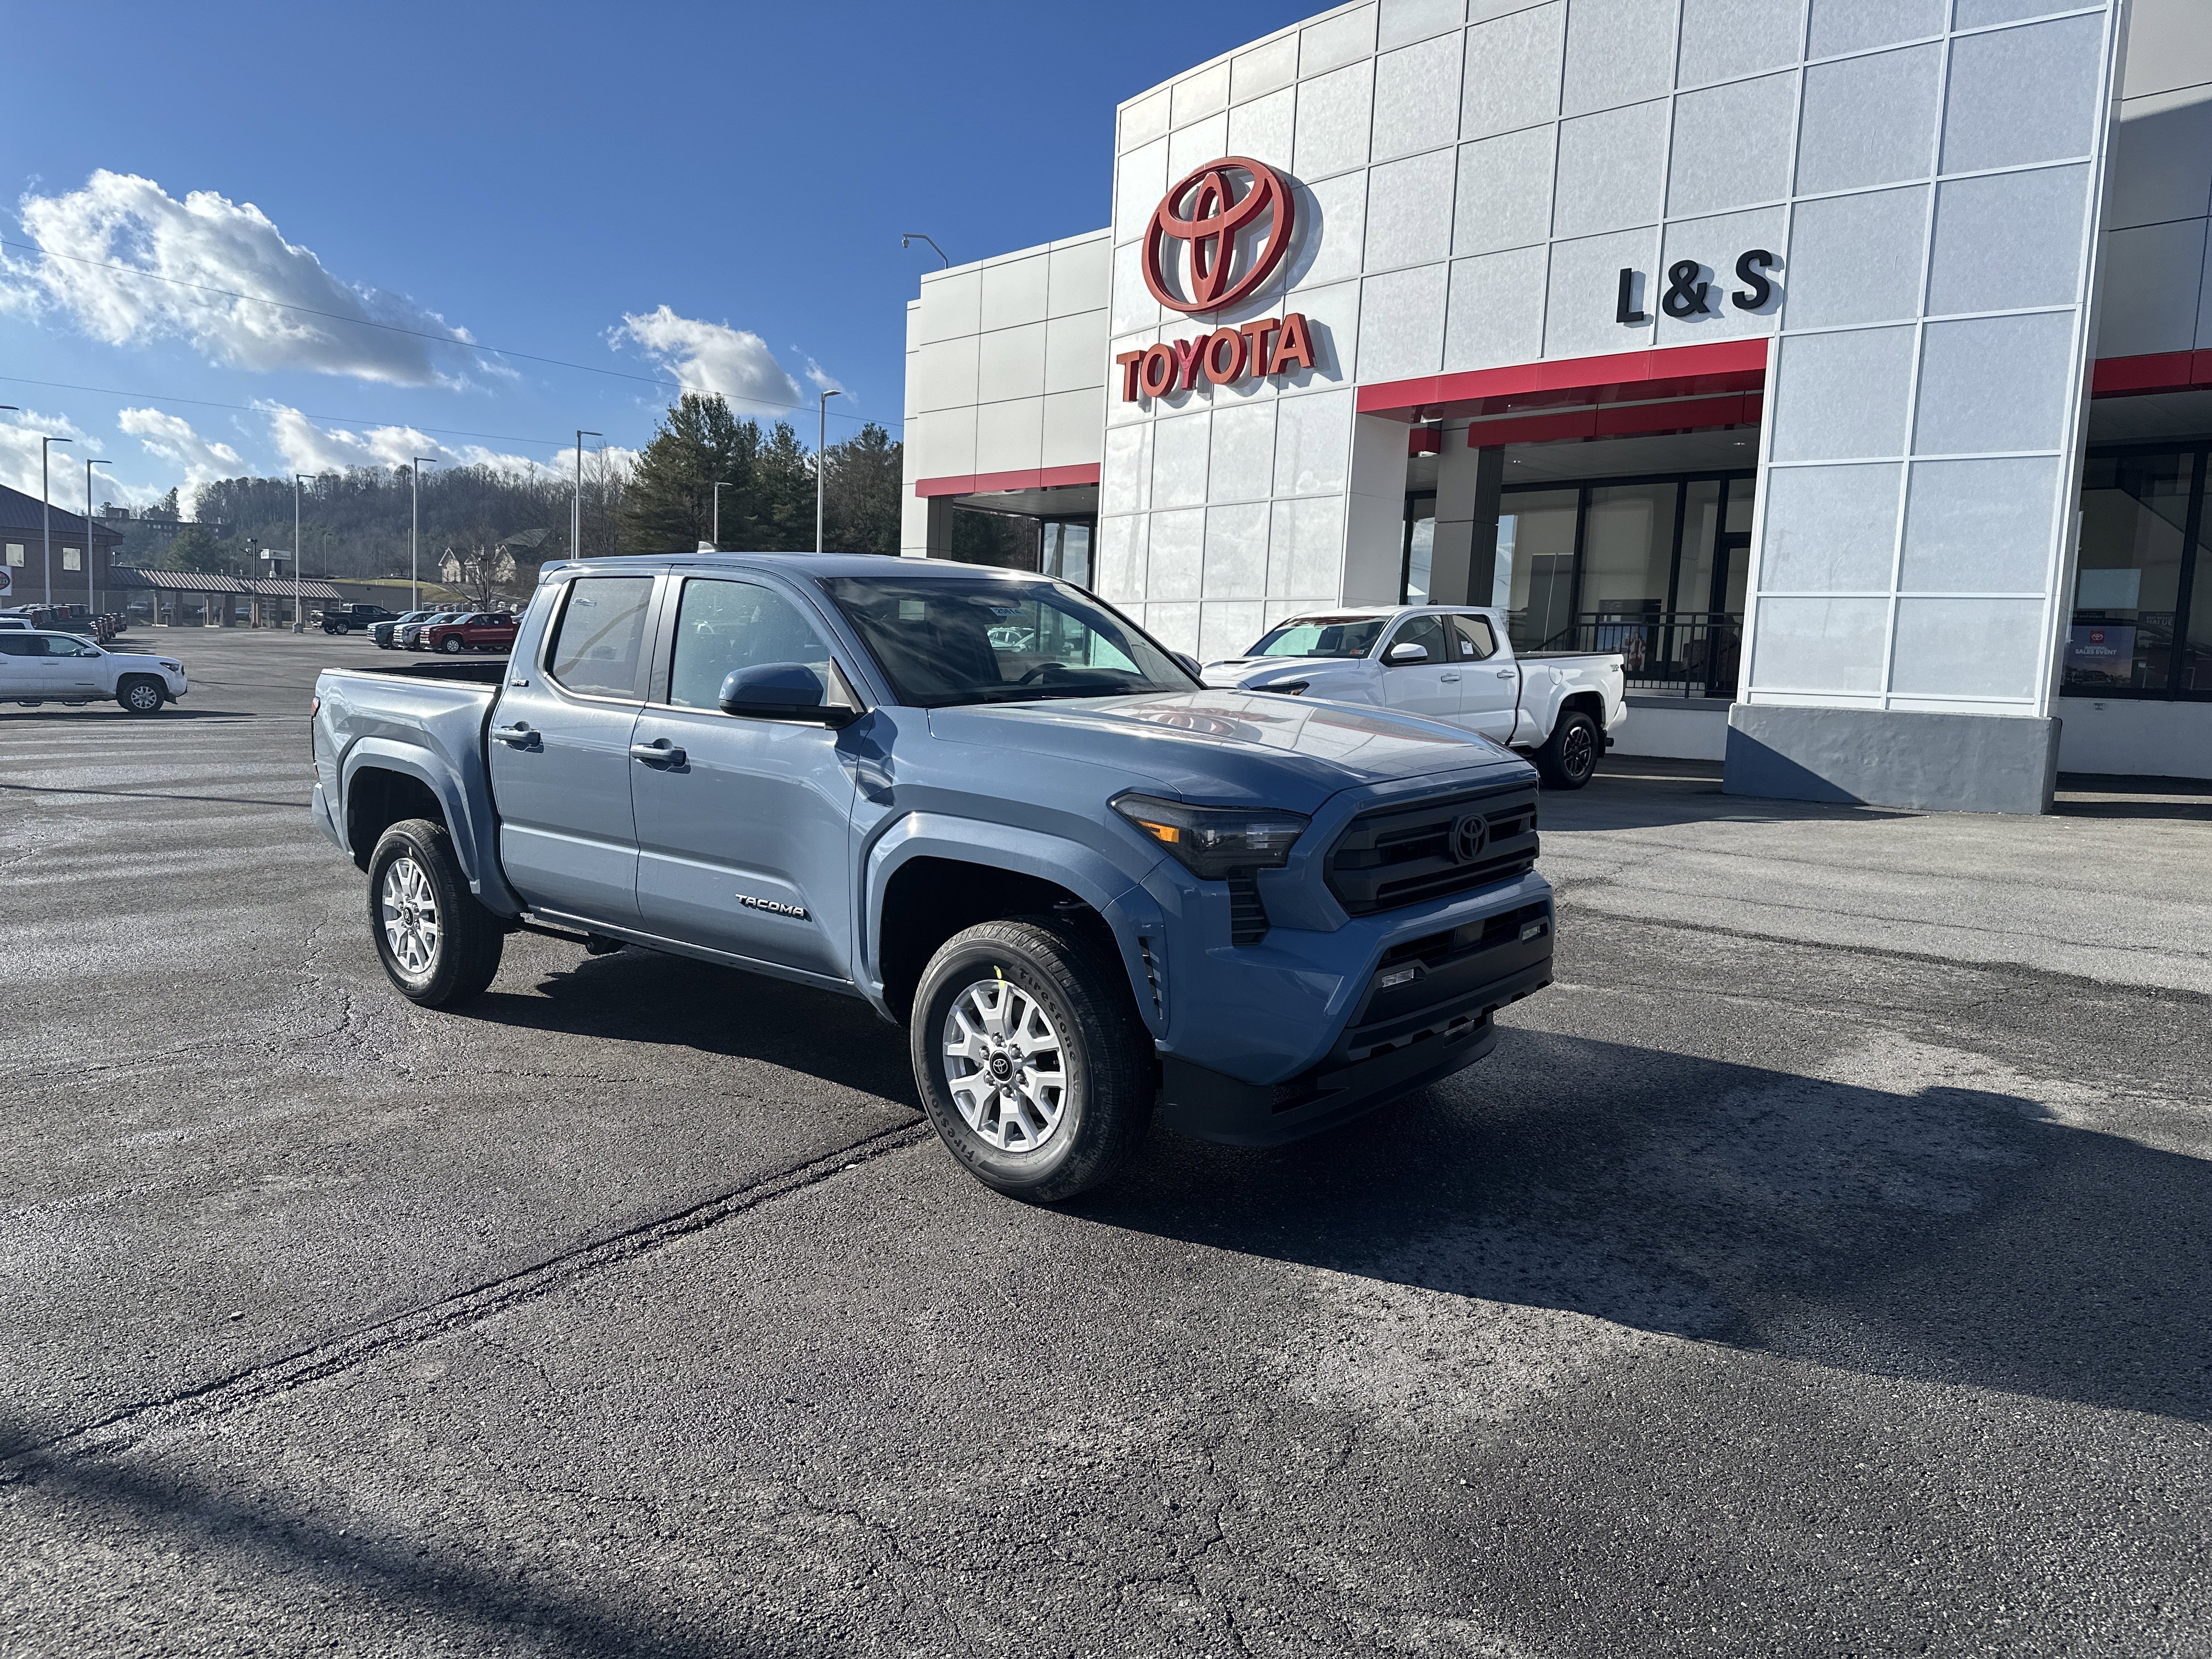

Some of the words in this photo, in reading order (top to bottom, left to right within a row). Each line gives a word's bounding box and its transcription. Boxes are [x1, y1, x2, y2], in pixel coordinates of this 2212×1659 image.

[1616, 267, 1644, 323] L
[1662, 259, 1711, 317] &
[1731, 249, 1773, 309] S
[1116, 312, 1314, 402] TOYOTA
[735, 893, 805, 918] TACOMA
